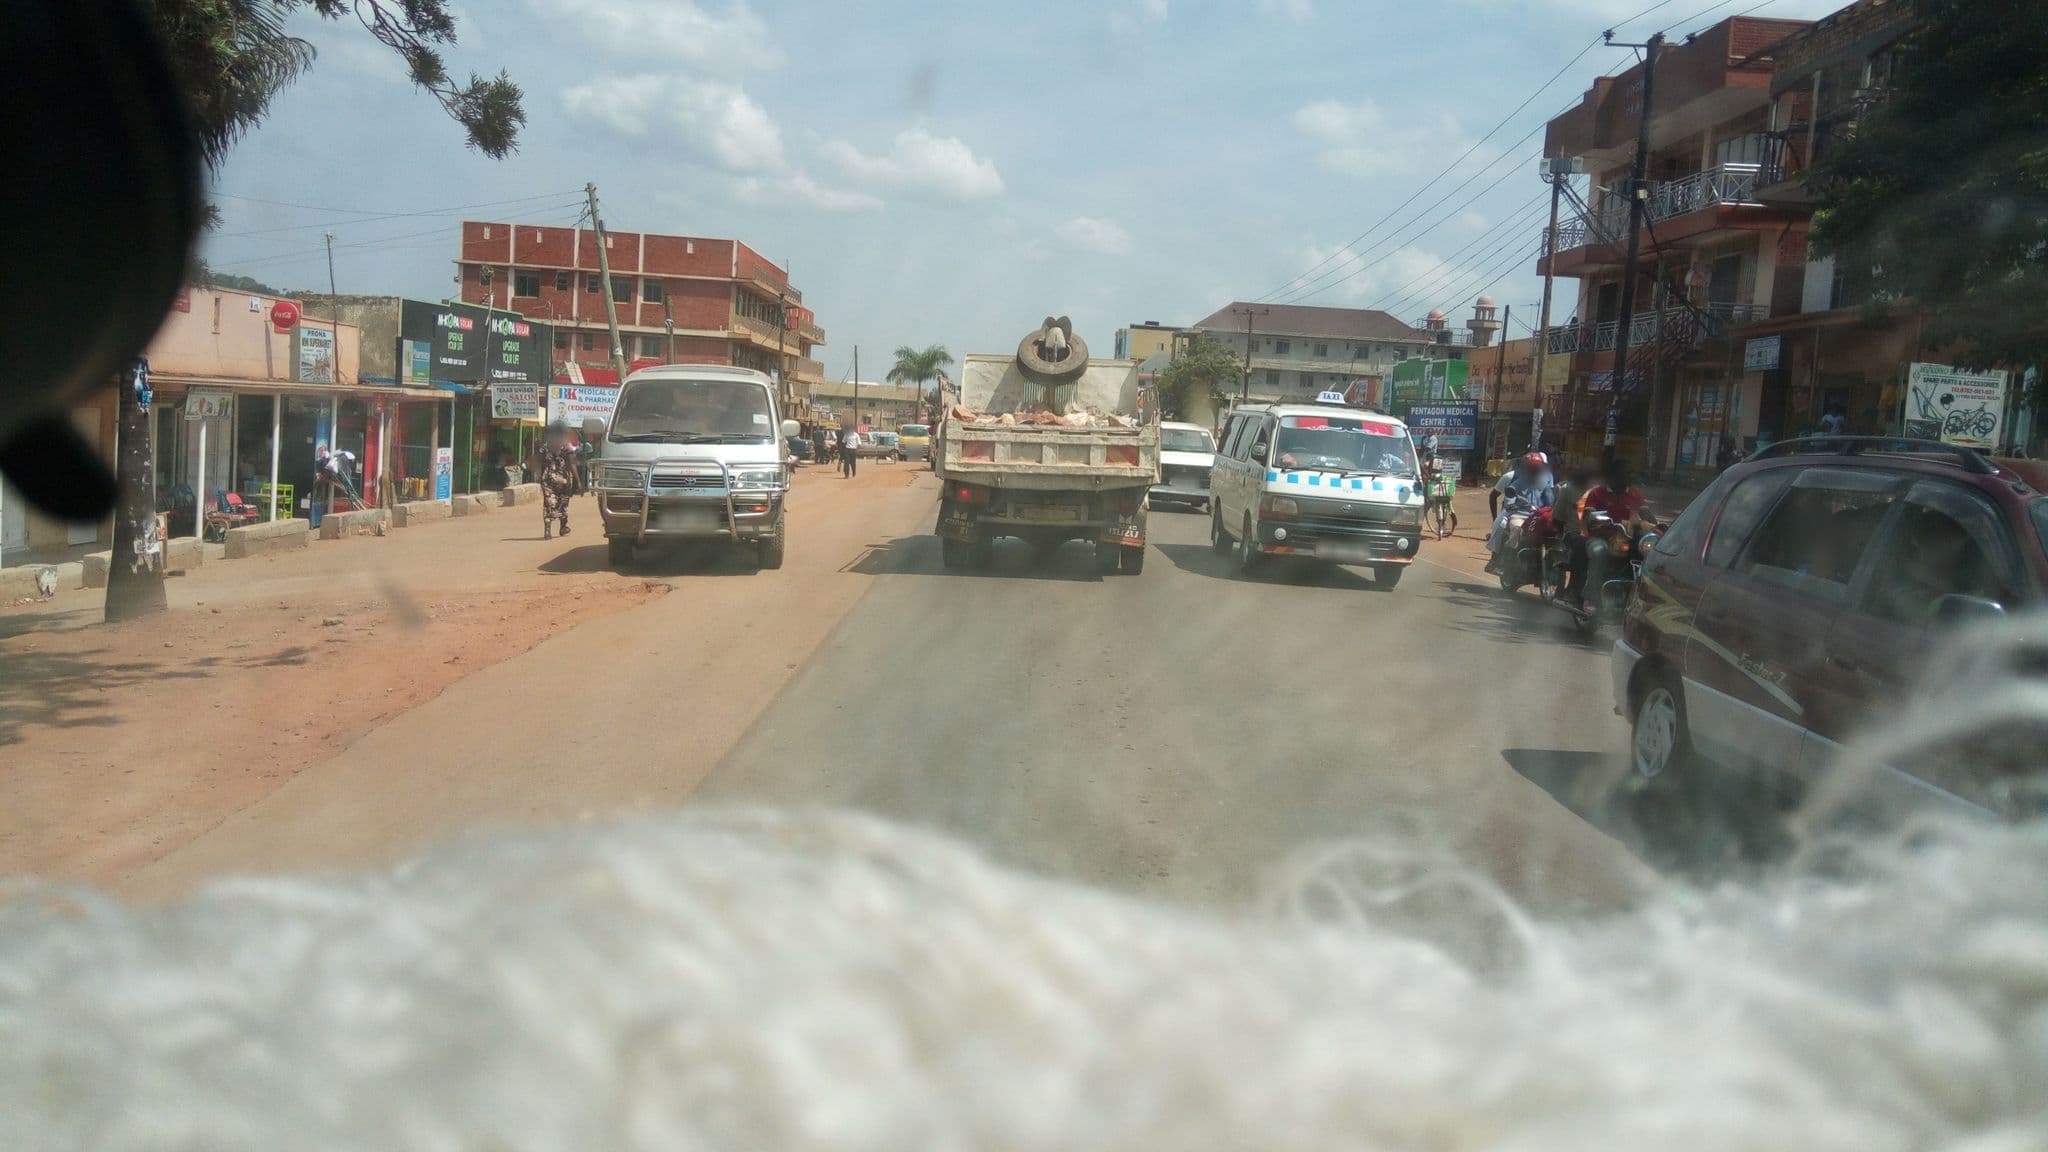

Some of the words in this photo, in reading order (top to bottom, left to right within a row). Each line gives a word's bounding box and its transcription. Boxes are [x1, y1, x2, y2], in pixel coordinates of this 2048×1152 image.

[579, 388, 607, 396] MEDICAL
[1410, 407, 1446, 416] PENTAGON
[1446, 407, 1474, 416] MEDICAL
[1420, 418, 1446, 426] CENTRE
